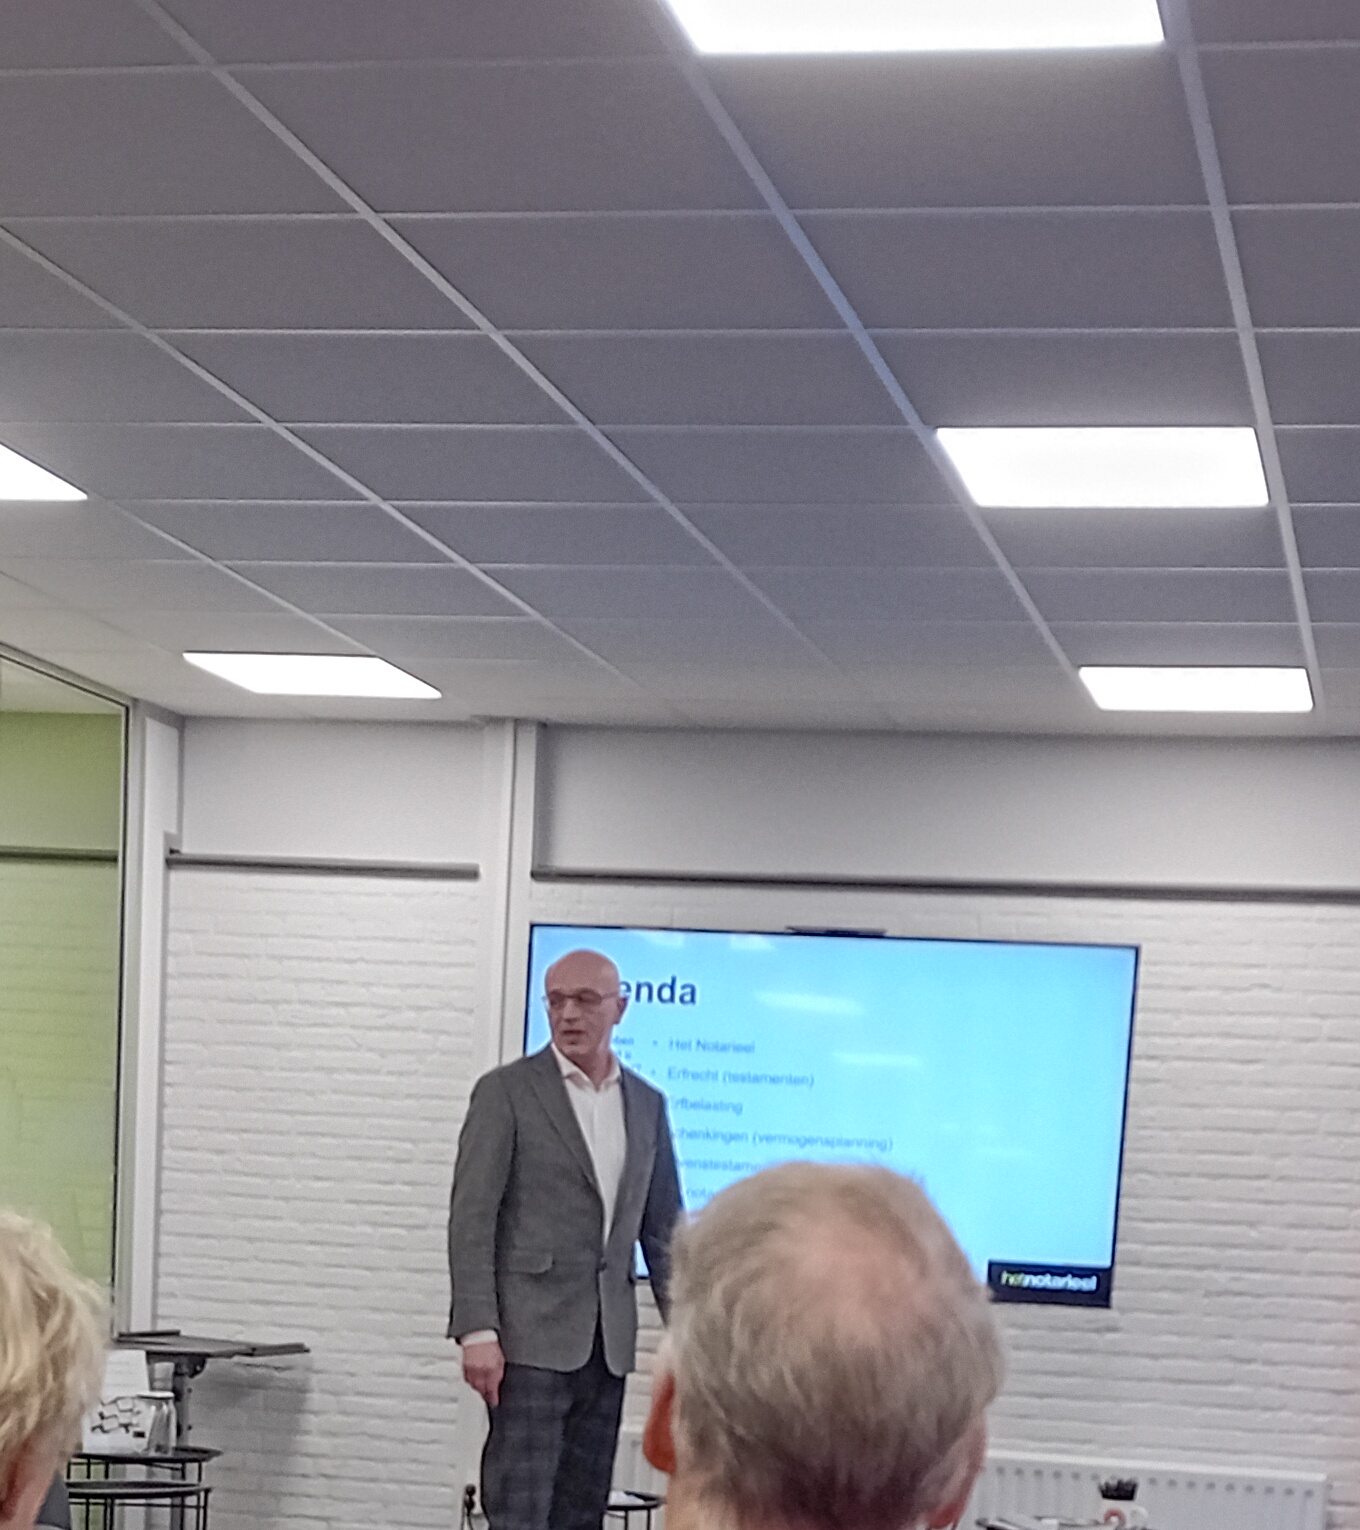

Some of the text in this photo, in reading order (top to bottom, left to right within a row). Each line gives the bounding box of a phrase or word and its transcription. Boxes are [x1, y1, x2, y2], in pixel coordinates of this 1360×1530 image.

[619, 974, 698, 1006] enda
[667, 1066, 719, 1082] Erfrecht
[674, 1096, 744, 1116] rfbelasting
